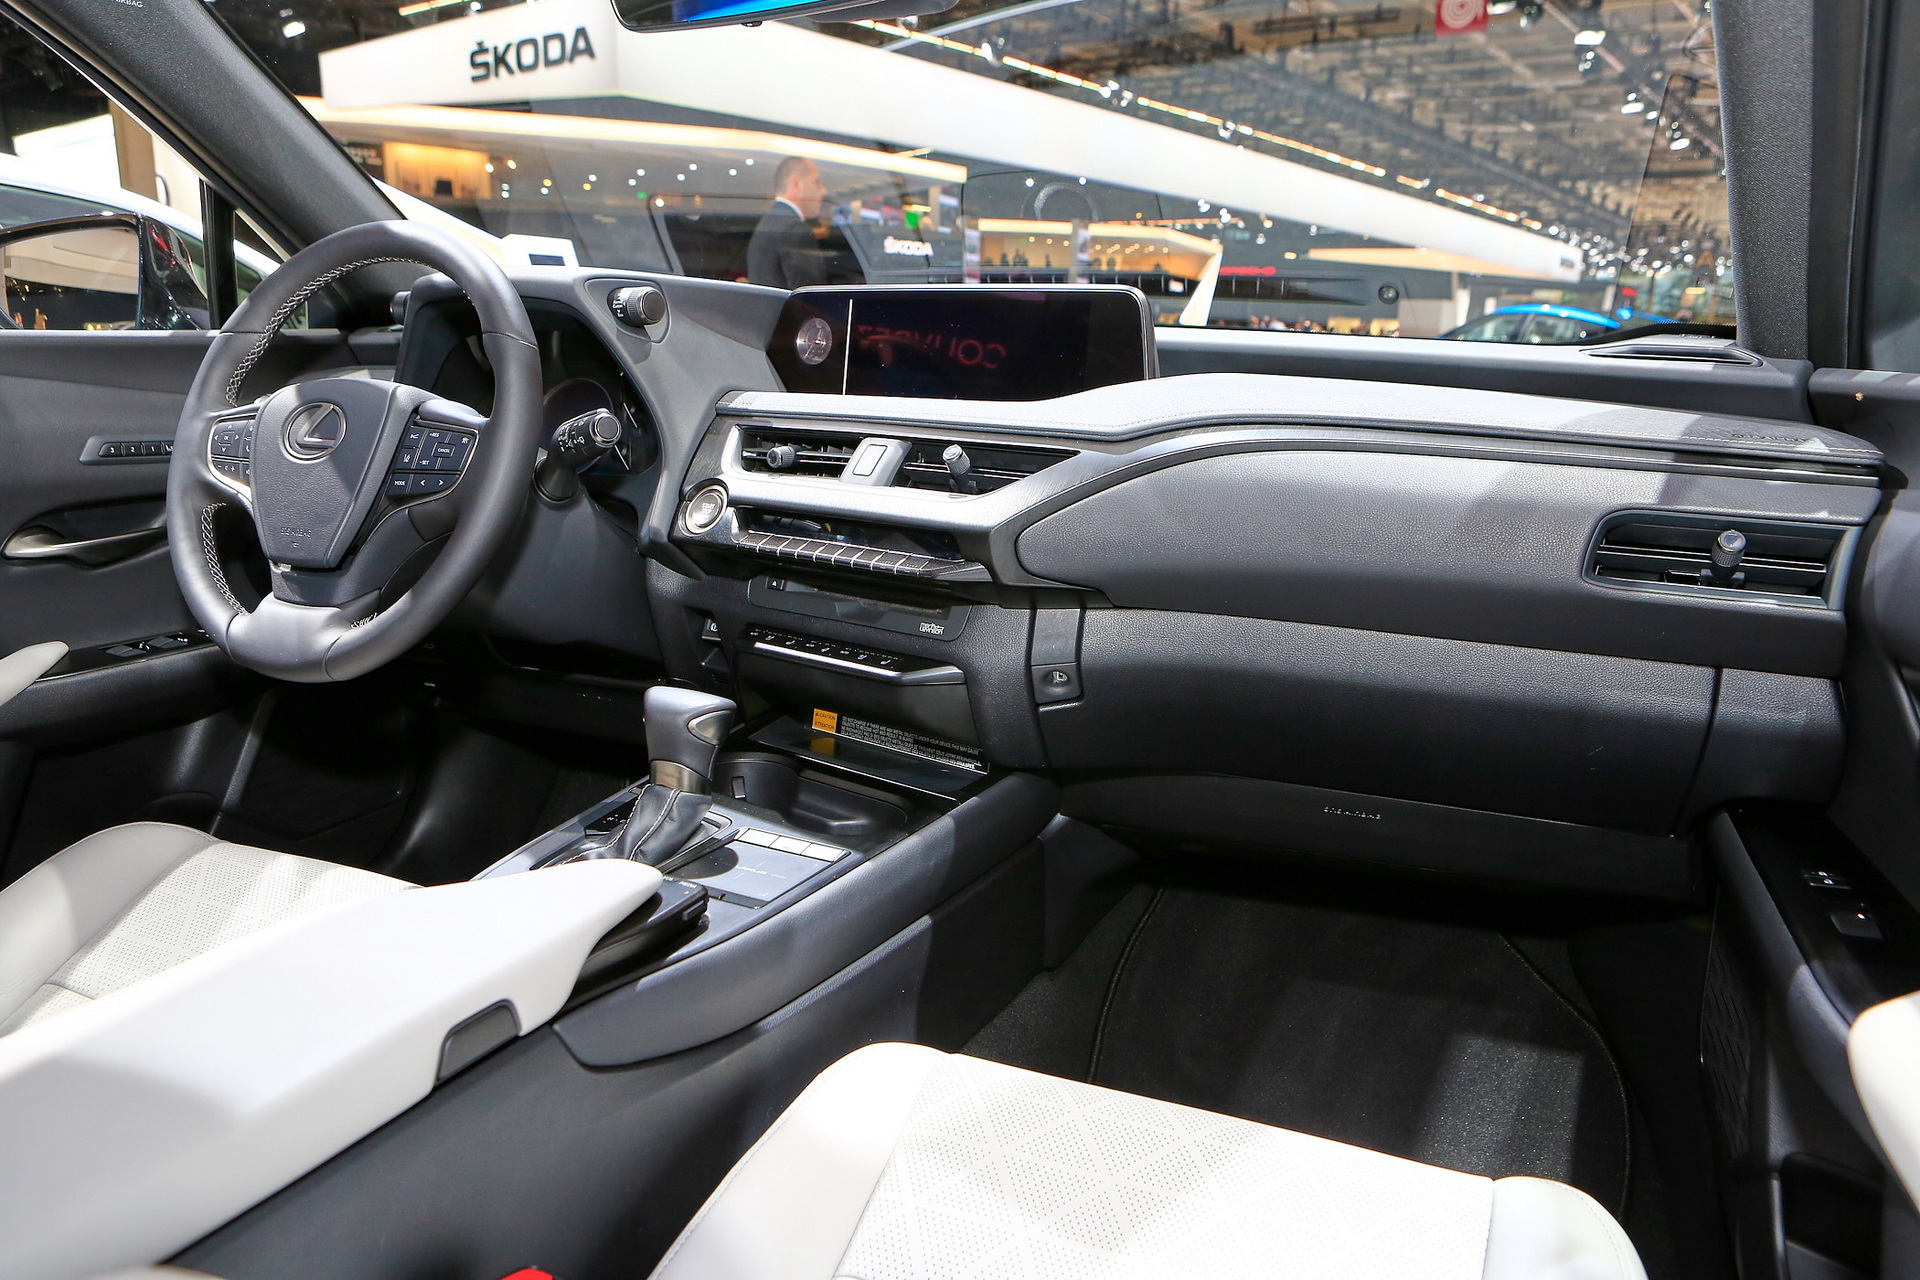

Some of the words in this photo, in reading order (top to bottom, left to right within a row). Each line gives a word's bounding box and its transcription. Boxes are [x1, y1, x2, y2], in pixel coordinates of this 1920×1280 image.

[470, 26, 596, 83] ŠKODA
[819, 712, 836, 721] CAUTION
[814, 721, 835, 730] ATTENTION
